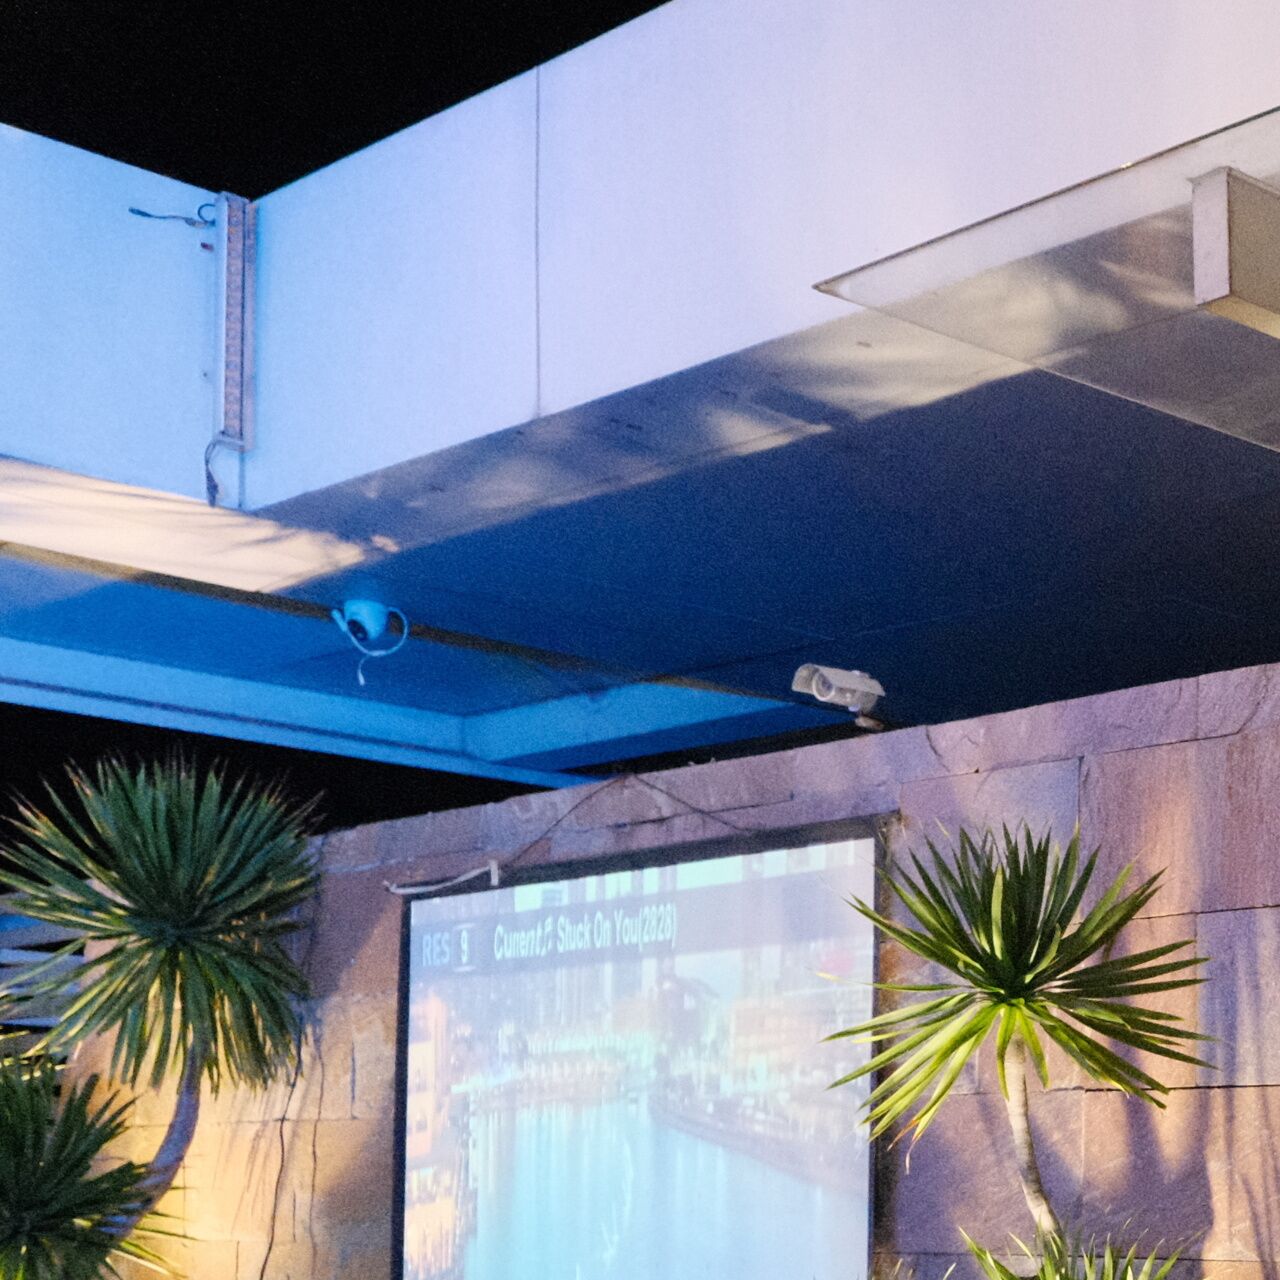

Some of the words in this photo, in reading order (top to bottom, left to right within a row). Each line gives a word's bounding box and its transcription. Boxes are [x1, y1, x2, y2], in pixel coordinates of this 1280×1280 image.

[422, 932, 450, 967] RES
[460, 929, 469, 964] 9
[556, 913, 590, 953] Stuck
[594, 911, 612, 949] On
